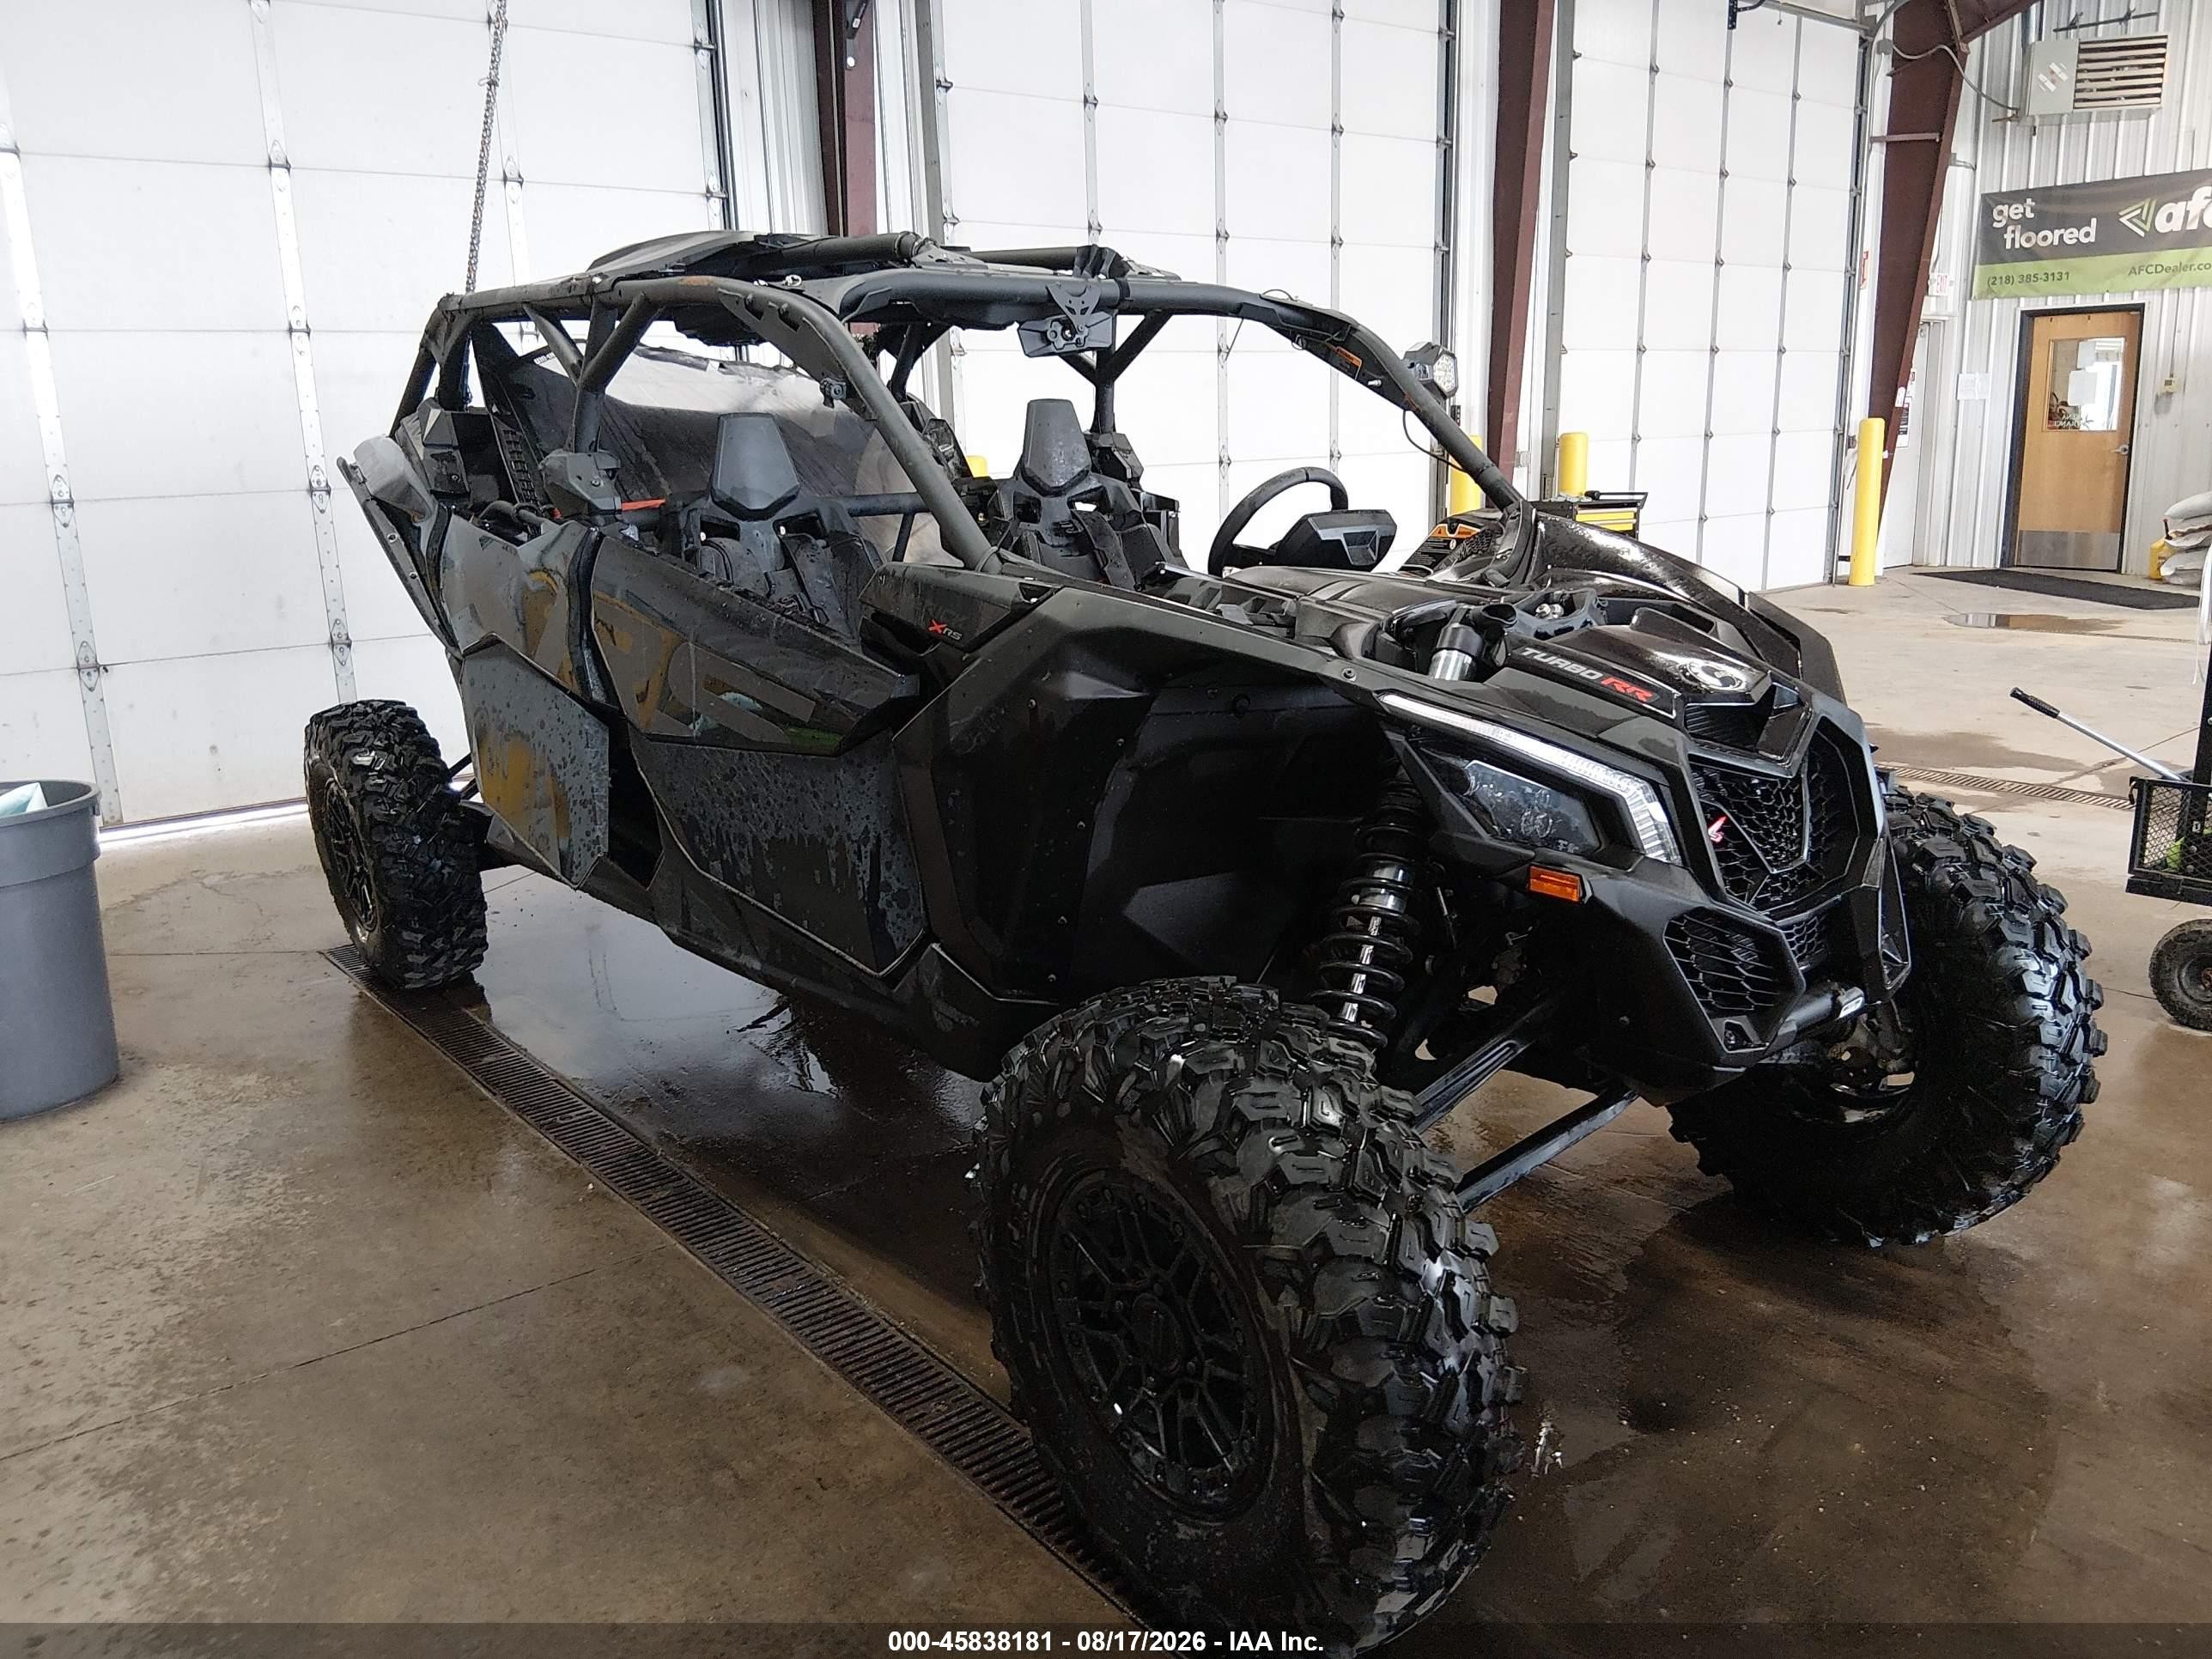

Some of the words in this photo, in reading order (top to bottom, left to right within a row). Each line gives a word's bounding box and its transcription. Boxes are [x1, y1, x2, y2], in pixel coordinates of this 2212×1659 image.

[1992, 198, 2035, 228] get
[2003, 217, 2097, 249] floored
[1987, 273, 2014, 287] (218)
[2018, 270, 2070, 284] 385-3131
[1521, 647, 1604, 680] TURBO
[1601, 677, 1653, 702] RR
